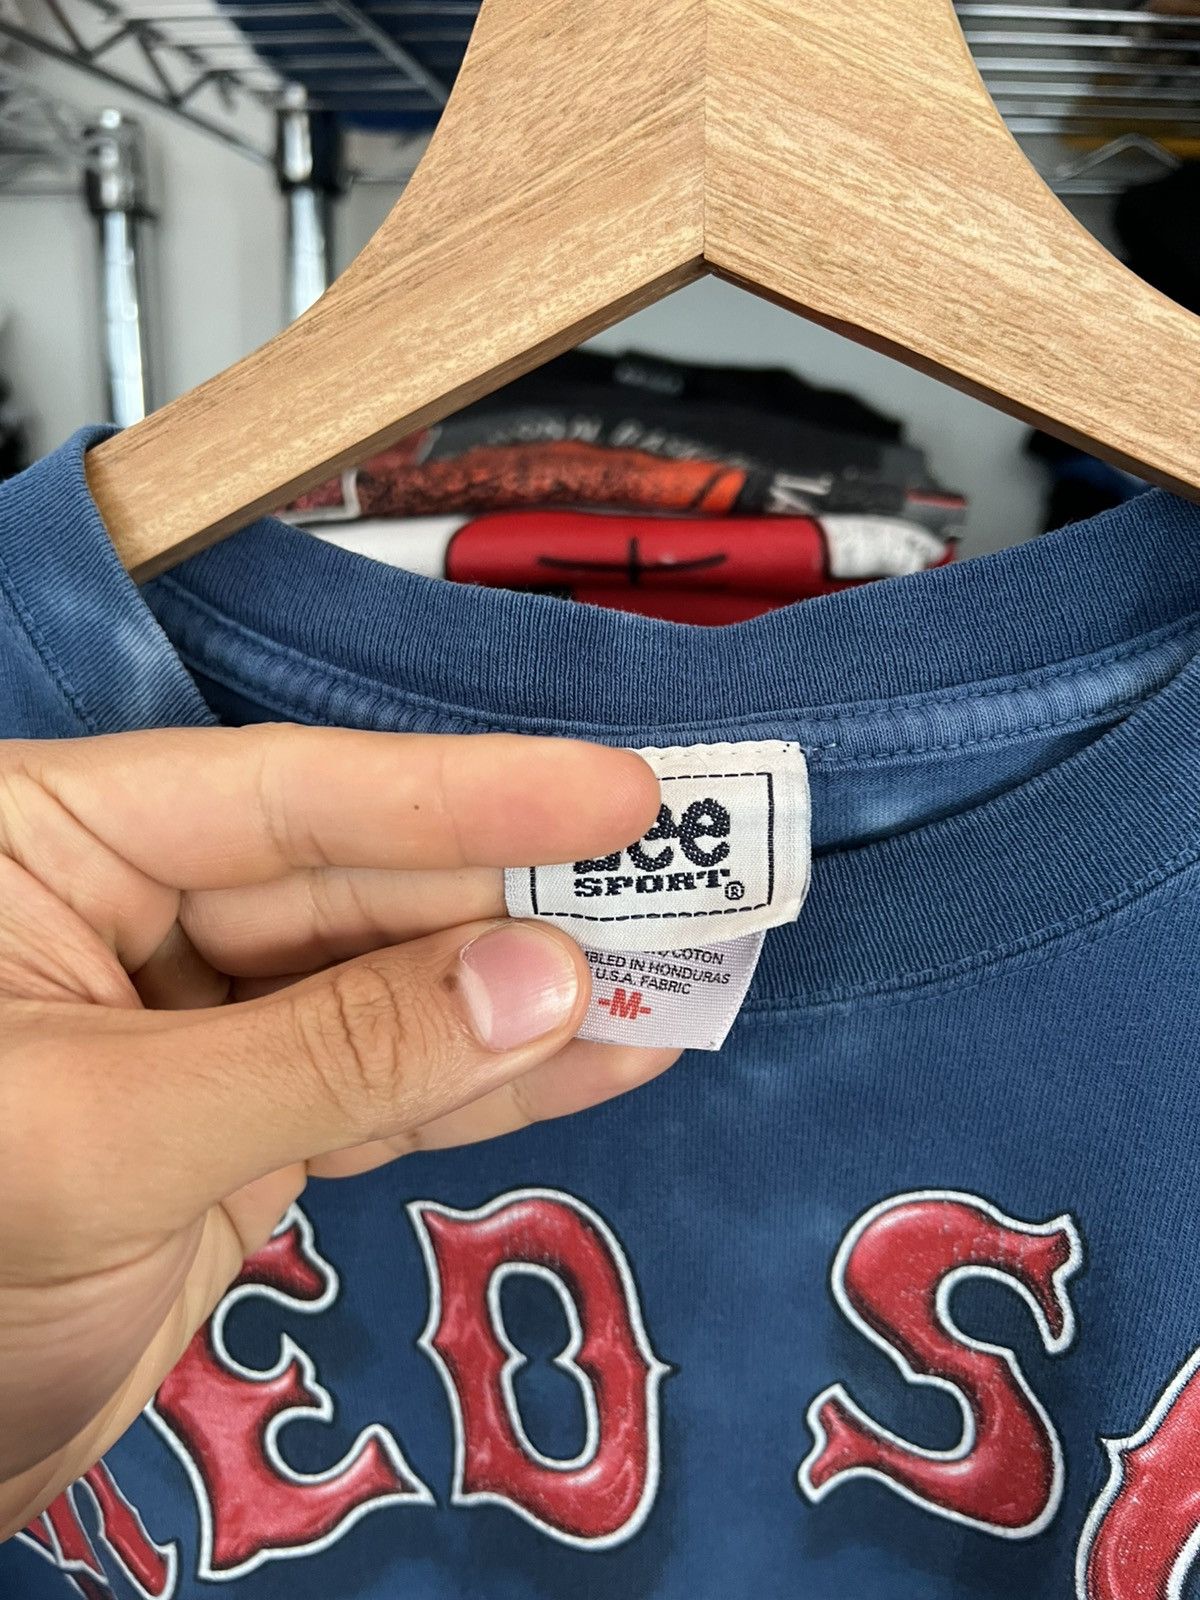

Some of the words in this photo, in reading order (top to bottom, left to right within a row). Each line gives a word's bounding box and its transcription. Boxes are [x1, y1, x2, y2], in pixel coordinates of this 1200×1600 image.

[573, 798, 731, 874] ee
[629, 958, 646, 972] IN
[648, 961, 732, 985] HONDURAS
[639, 975, 692, 995] FABRIC
